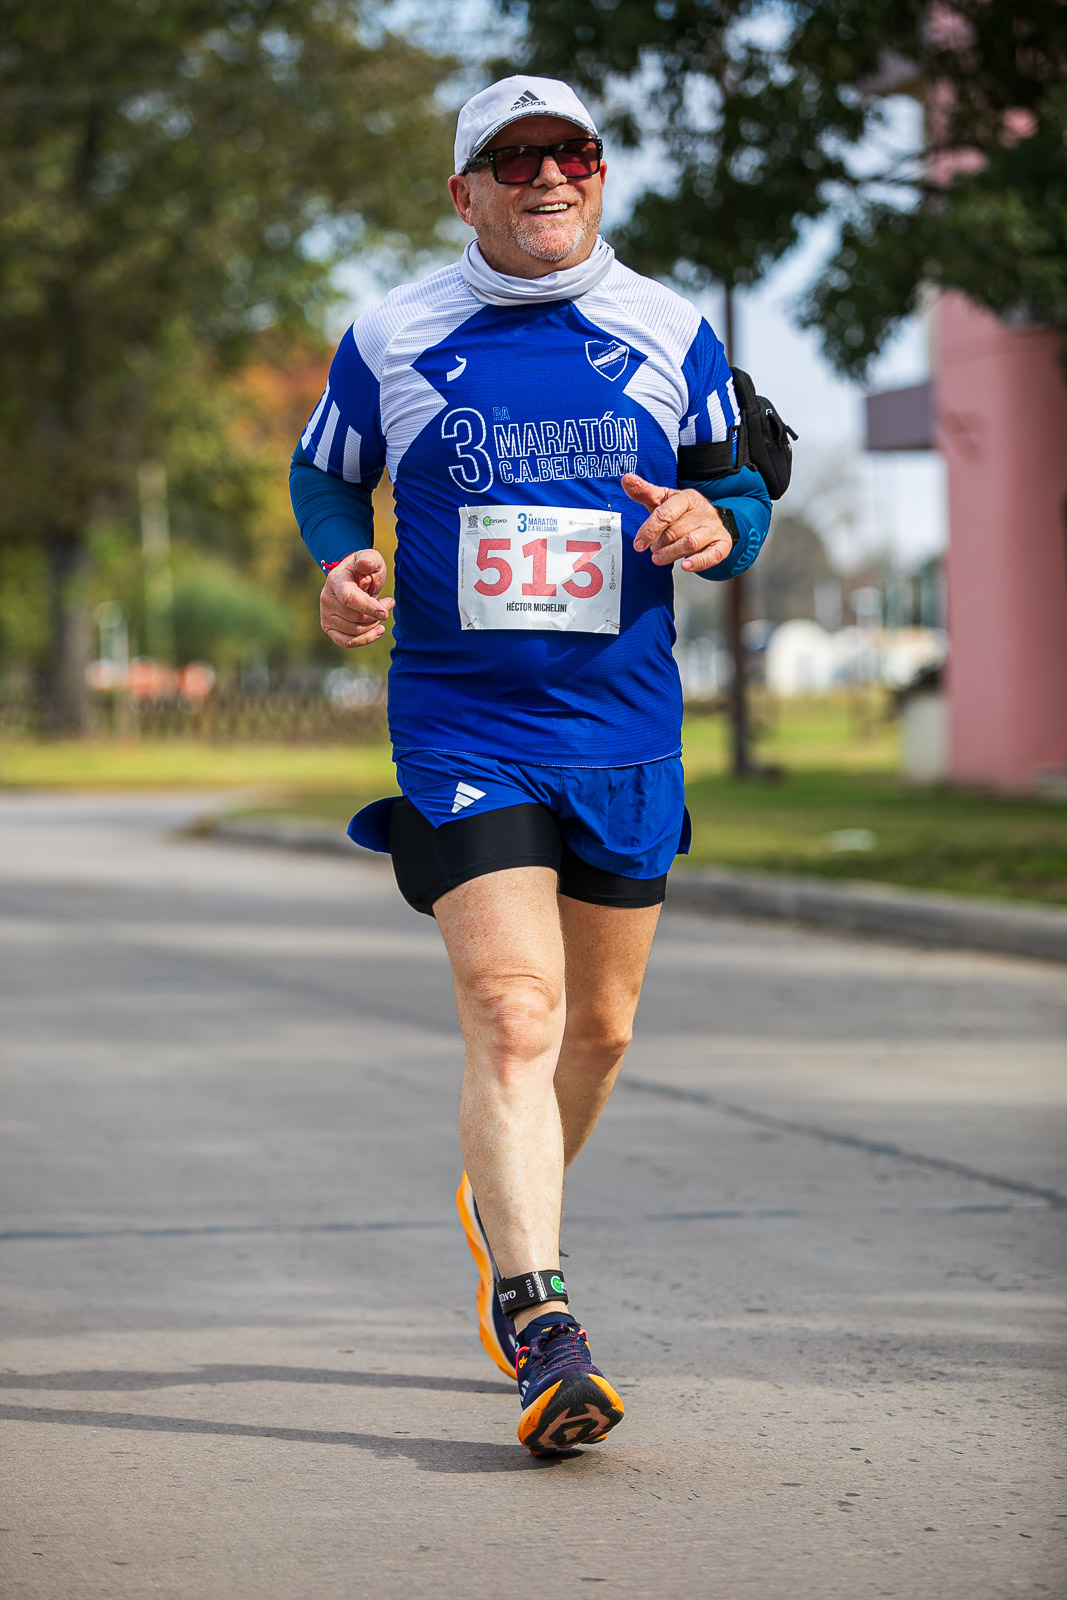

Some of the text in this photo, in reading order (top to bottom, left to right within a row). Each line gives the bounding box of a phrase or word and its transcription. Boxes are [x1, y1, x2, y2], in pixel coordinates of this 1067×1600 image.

[510, 101, 547, 111] adidas
[493, 411, 638, 458] MARATÓN
[441, 407, 494, 494] 3
[492, 406, 511, 421] RA
[517, 513, 528, 533] 3
[528, 517, 558, 526] MARATÓN
[473, 538, 604, 599] 513
[506, 601, 568, 613] HÉCTOR MICHELINI
[525, 1279, 535, 1298] CV513
